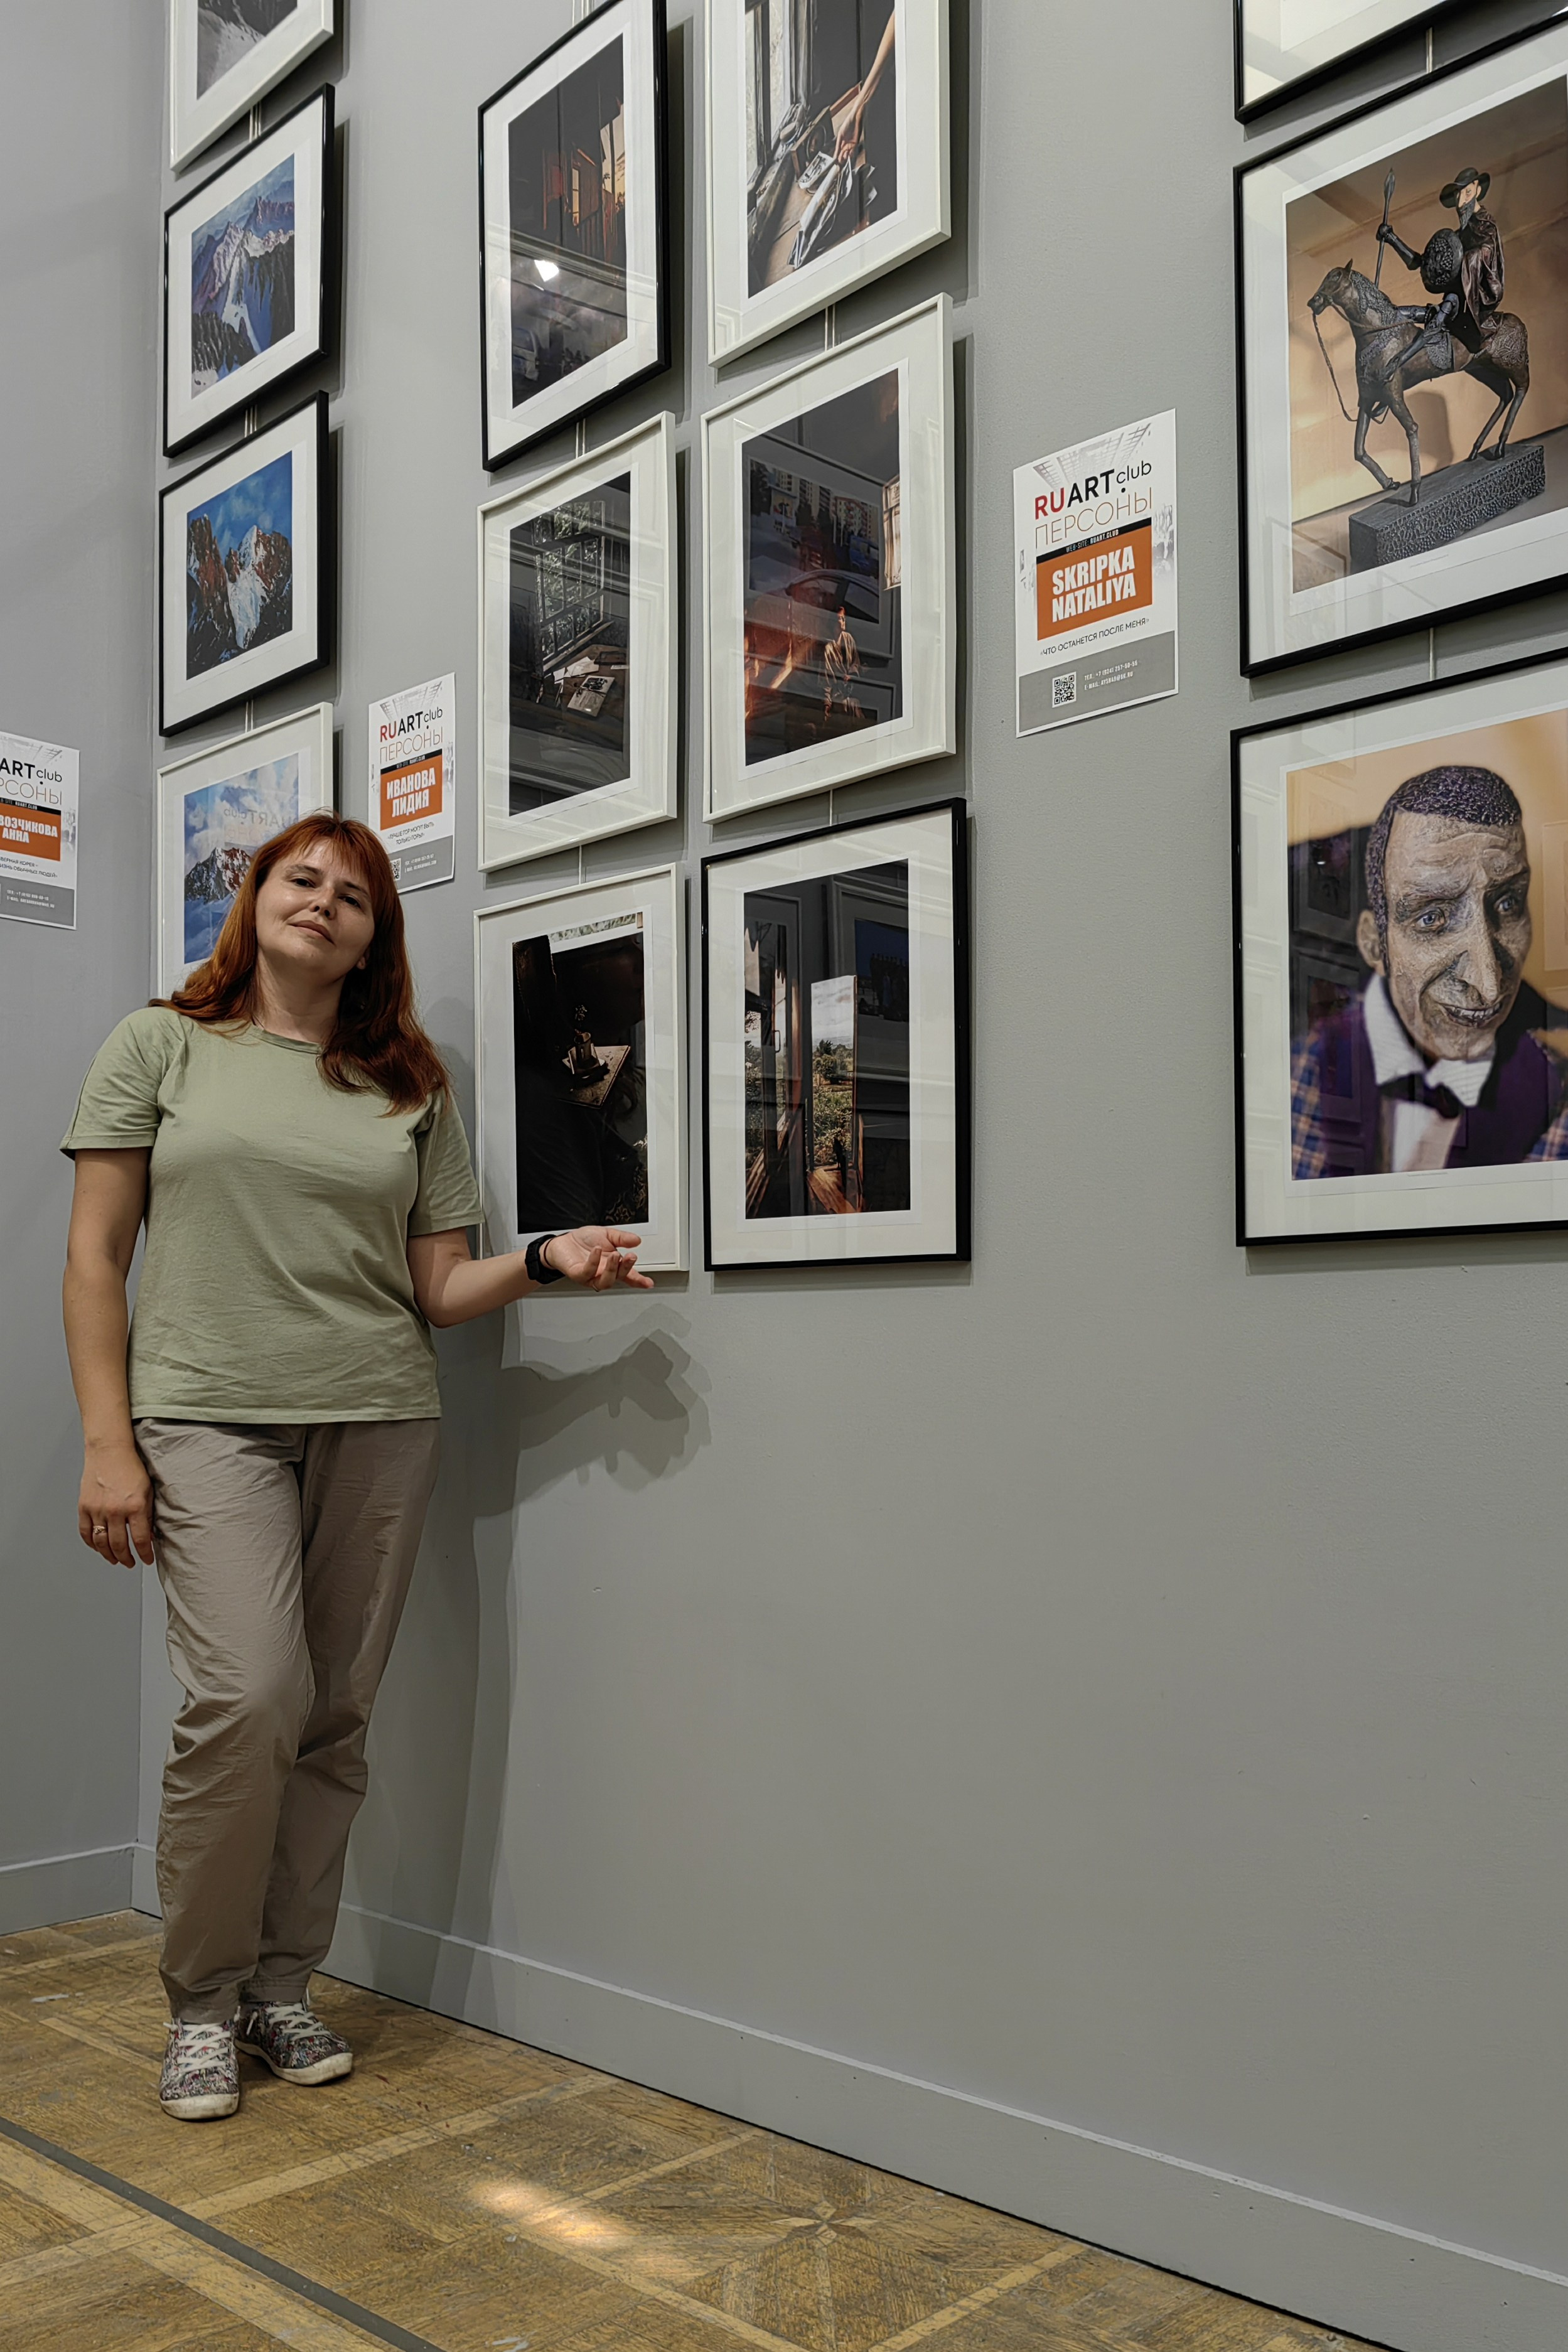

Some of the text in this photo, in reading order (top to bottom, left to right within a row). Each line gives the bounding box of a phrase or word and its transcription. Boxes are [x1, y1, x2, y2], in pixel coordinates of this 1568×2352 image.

[1036, 487, 1152, 549] ПЕРСОНЫ
[1090, 529, 1119, 544] RUART.CLUB
[1052, 545, 1135, 595] SKRIPKA
[1052, 572, 1136, 623] NATALIYA
[1058, 633, 1098, 651] ОСТАНЕТСЯ
[1098, 624, 1124, 638] ПОСЛЕ
[380, 726, 443, 765] ПЕРСОНЫ
[387, 768, 436, 800] ИВАНОВА
[392, 788, 429, 818] ЛИДИЯ
[3, 827, 30, 843] АННА
